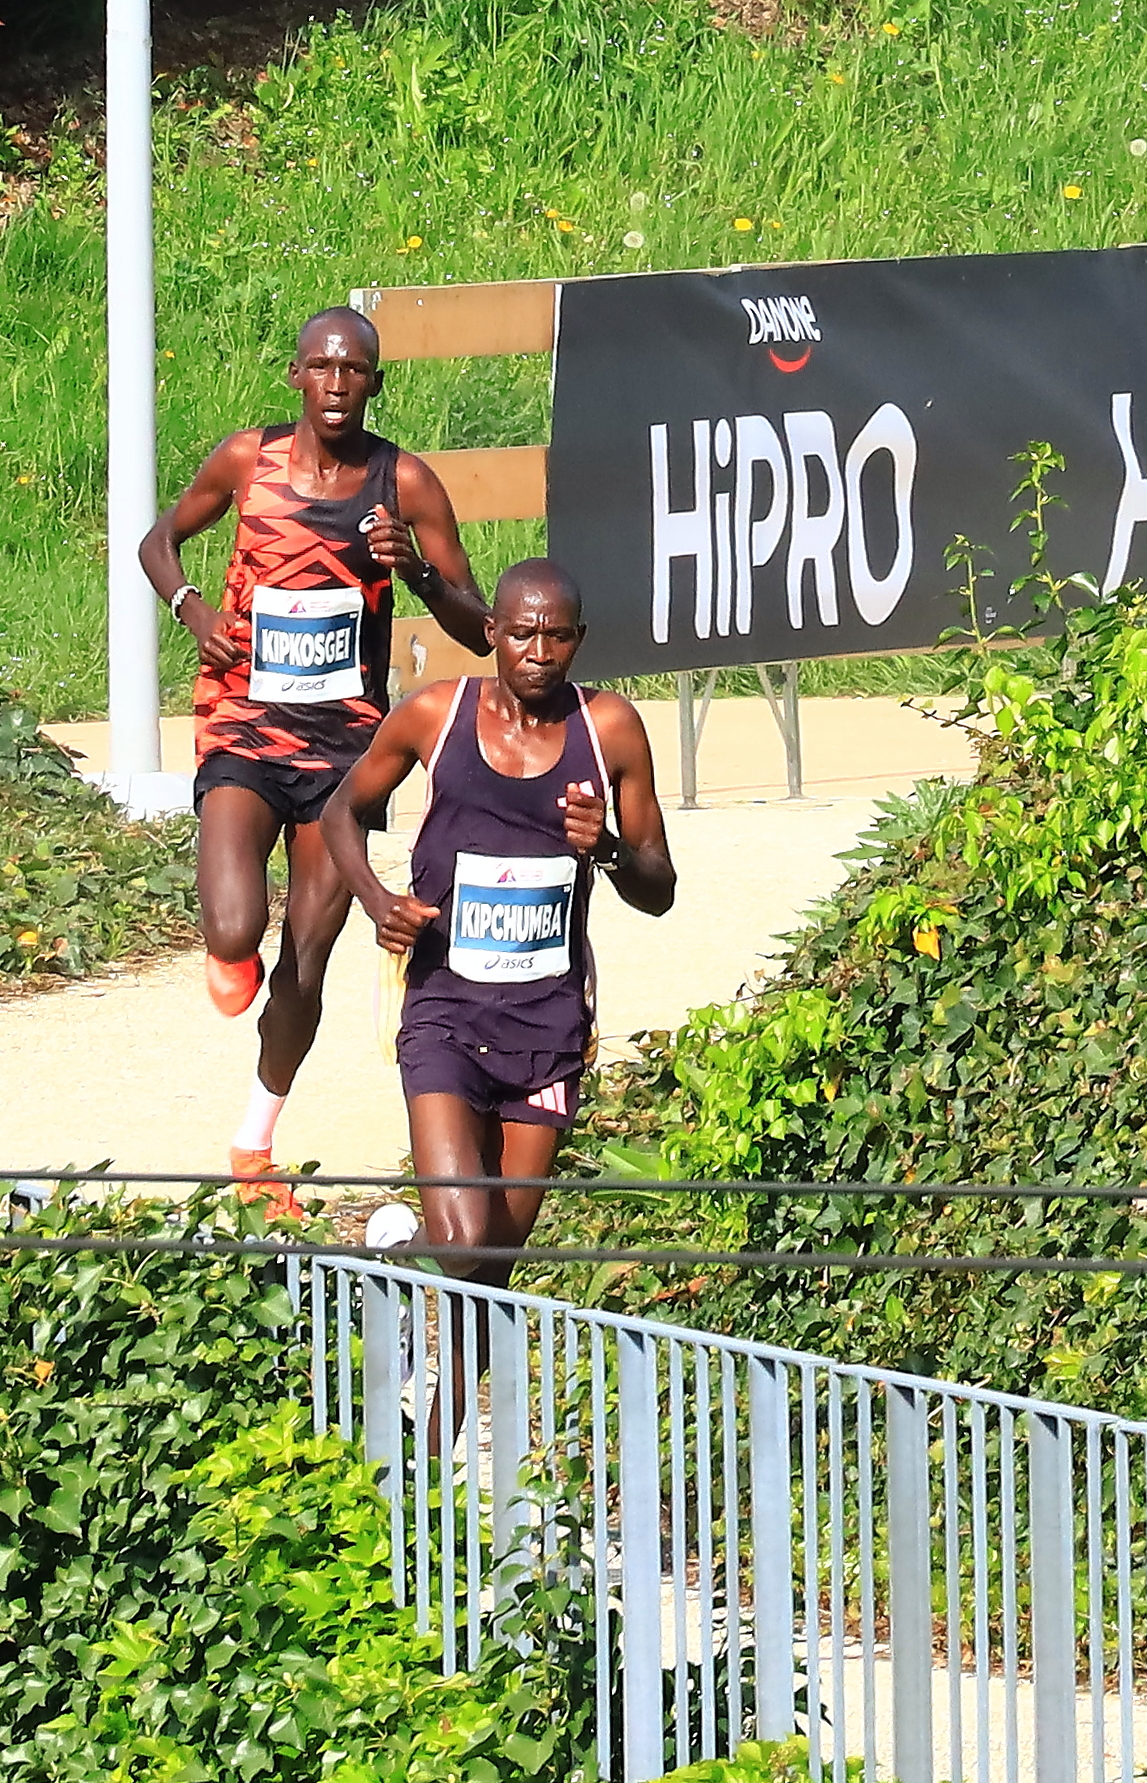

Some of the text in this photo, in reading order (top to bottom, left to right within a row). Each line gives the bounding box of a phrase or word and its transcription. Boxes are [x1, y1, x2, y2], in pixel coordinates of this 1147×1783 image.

[650, 402, 918, 644] HiPRO
[261, 627, 351, 668] KIPKOSGEI
[461, 901, 562, 943] KIPCHUMBA
[501, 956, 535, 969] asics
